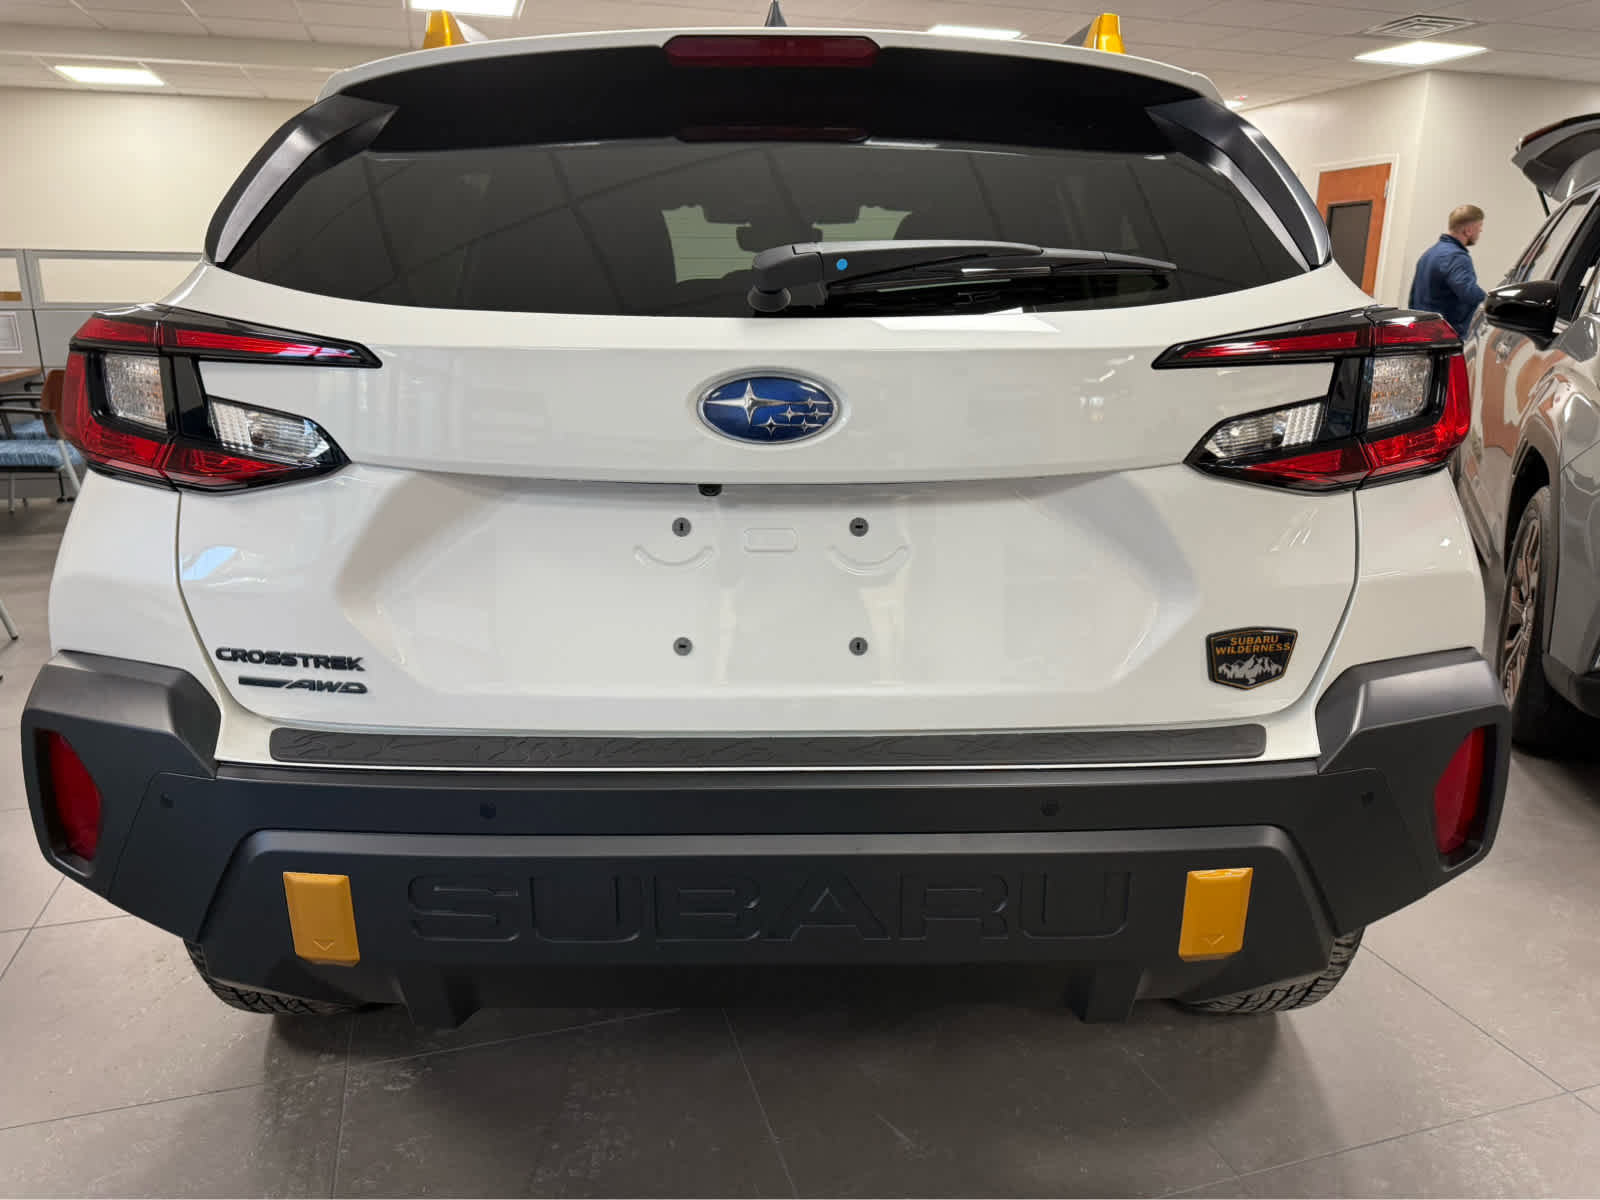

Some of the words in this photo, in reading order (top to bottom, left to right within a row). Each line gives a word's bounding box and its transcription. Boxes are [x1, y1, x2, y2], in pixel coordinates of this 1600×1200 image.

[1230, 635, 1279, 646] SUBARU
[1215, 643, 1291, 655] WILDERNESS
[215, 647, 366, 671] CROSSTREK
[285, 679, 368, 695] AWD
[407, 871, 1131, 943] SUBARU
